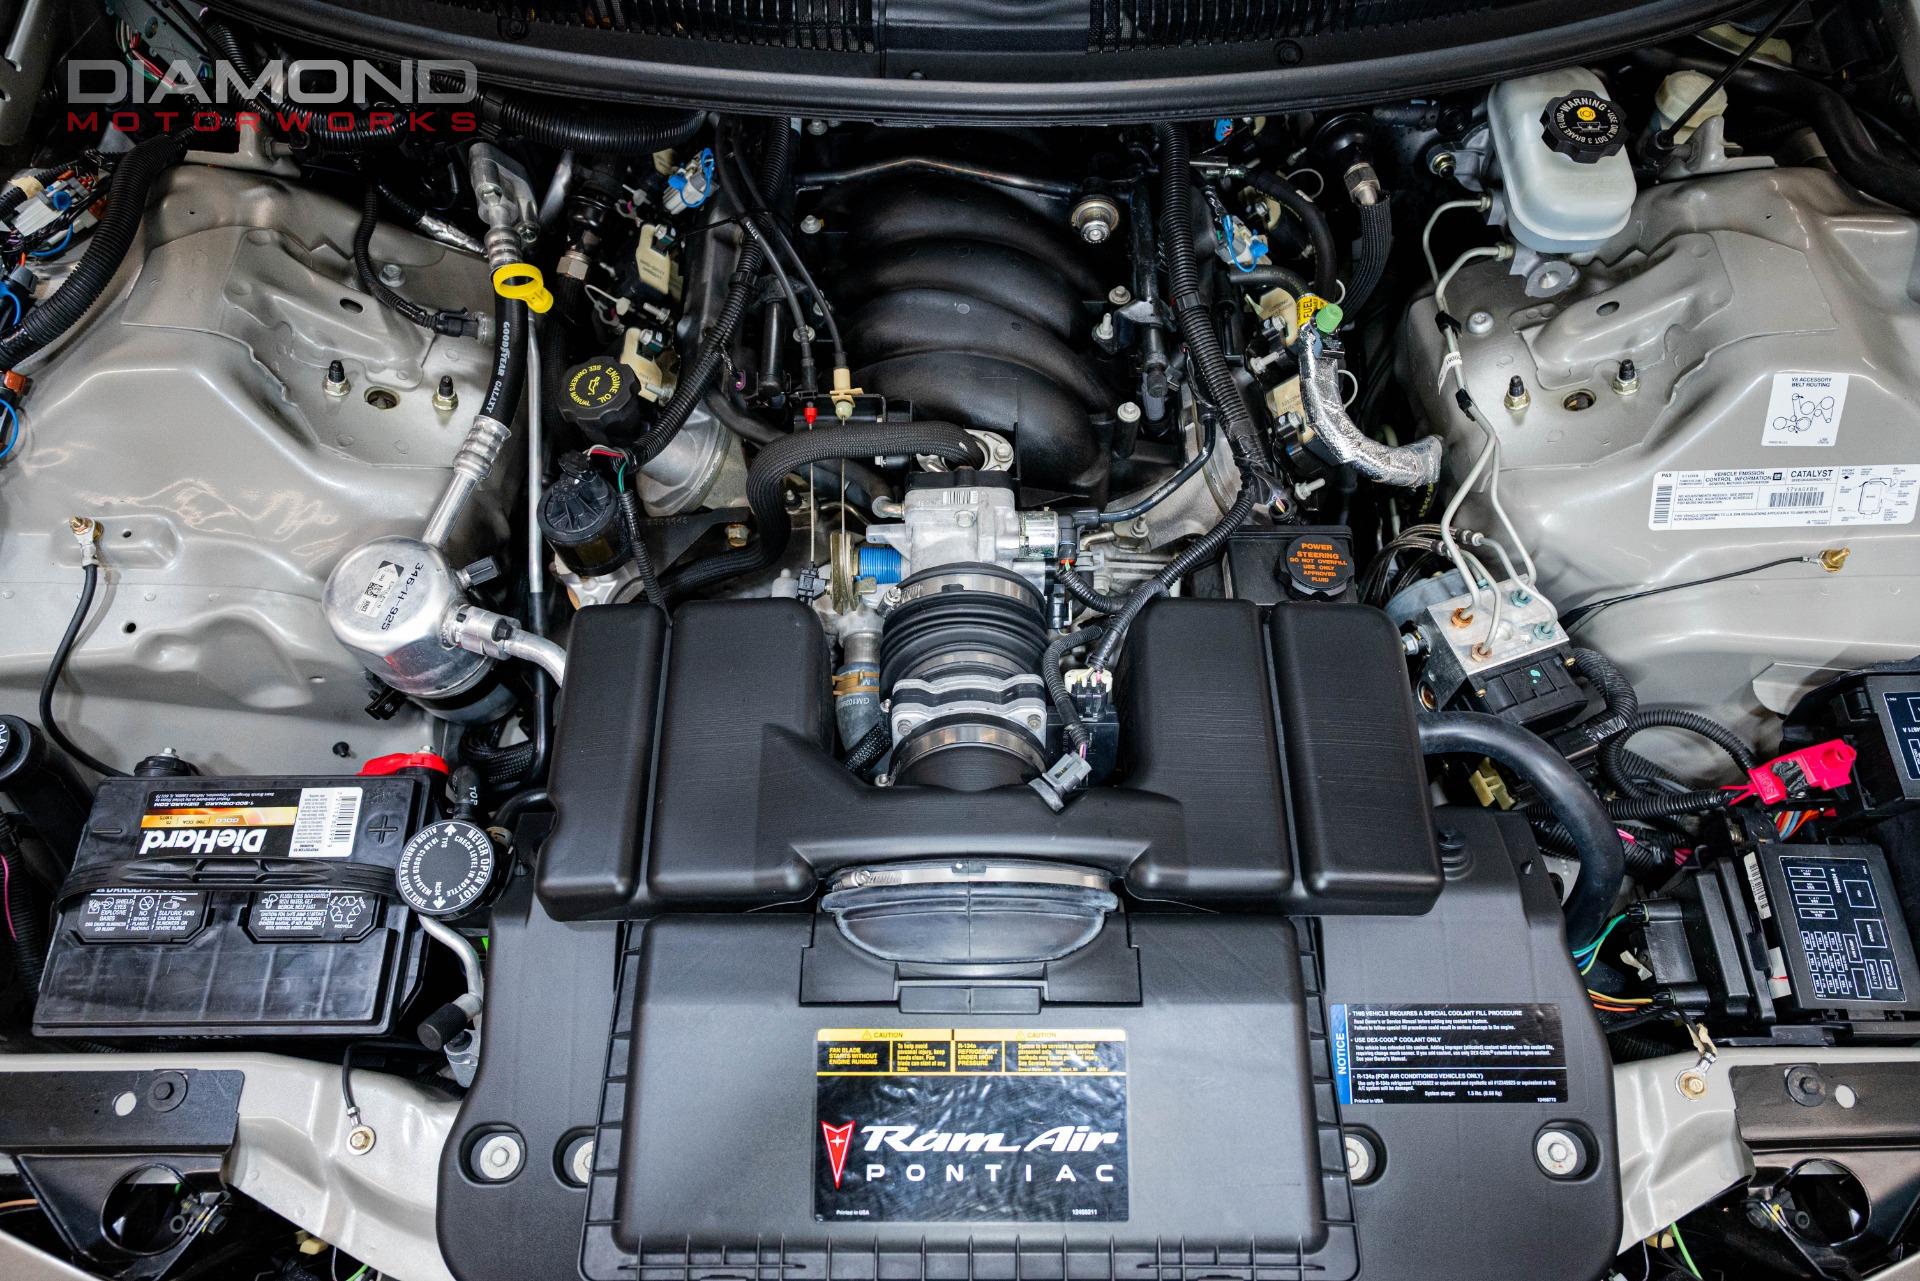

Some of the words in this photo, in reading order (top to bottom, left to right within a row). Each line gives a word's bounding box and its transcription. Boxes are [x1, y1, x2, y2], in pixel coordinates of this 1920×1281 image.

[1560, 98, 1606, 112] WARNING
[1556, 112, 1567, 129] FLUID
[1564, 128, 1586, 143] BRAKE
[1594, 136, 1608, 144] DOT
[1606, 124, 1618, 138] ONLY
[1304, 298, 1312, 318] FUEL
[497, 321, 511, 377] GOODYEAR
[569, 368, 588, 392] OWNER'S
[605, 366, 621, 394] ENGINE
[486, 380, 502, 414] GALAXY
[570, 392, 591, 406] MANUAL
[596, 393, 612, 404] OIL
[1791, 469, 1833, 478] CATALYST
[1296, 551, 1339, 560] STEERING
[468, 786, 478, 806] TOP
[139, 829, 267, 854] DieHard
[416, 826, 437, 844] ALIGN
[454, 836, 474, 851] CHECK
[467, 829, 488, 856] NEVER
[401, 843, 418, 869] ARROW
[412, 850, 426, 874] CLOSED
[469, 850, 478, 868] LEVEL
[468, 870, 476, 878] IN
[474, 858, 490, 885] OPEN
[400, 875, 413, 894] VENT
[413, 874, 432, 896] SYSTEM
[446, 878, 470, 897] BOTTLE
[458, 884, 478, 904] HOT
[409, 892, 428, 907] TUBE
[1866, 924, 1875, 942] STARTER
[1337, 1032, 1347, 1076] NOTICE
[861, 1125, 1022, 1152] Ram
[1023, 1125, 1119, 1152] Air
[866, 1164, 1114, 1182] PONTIAC
